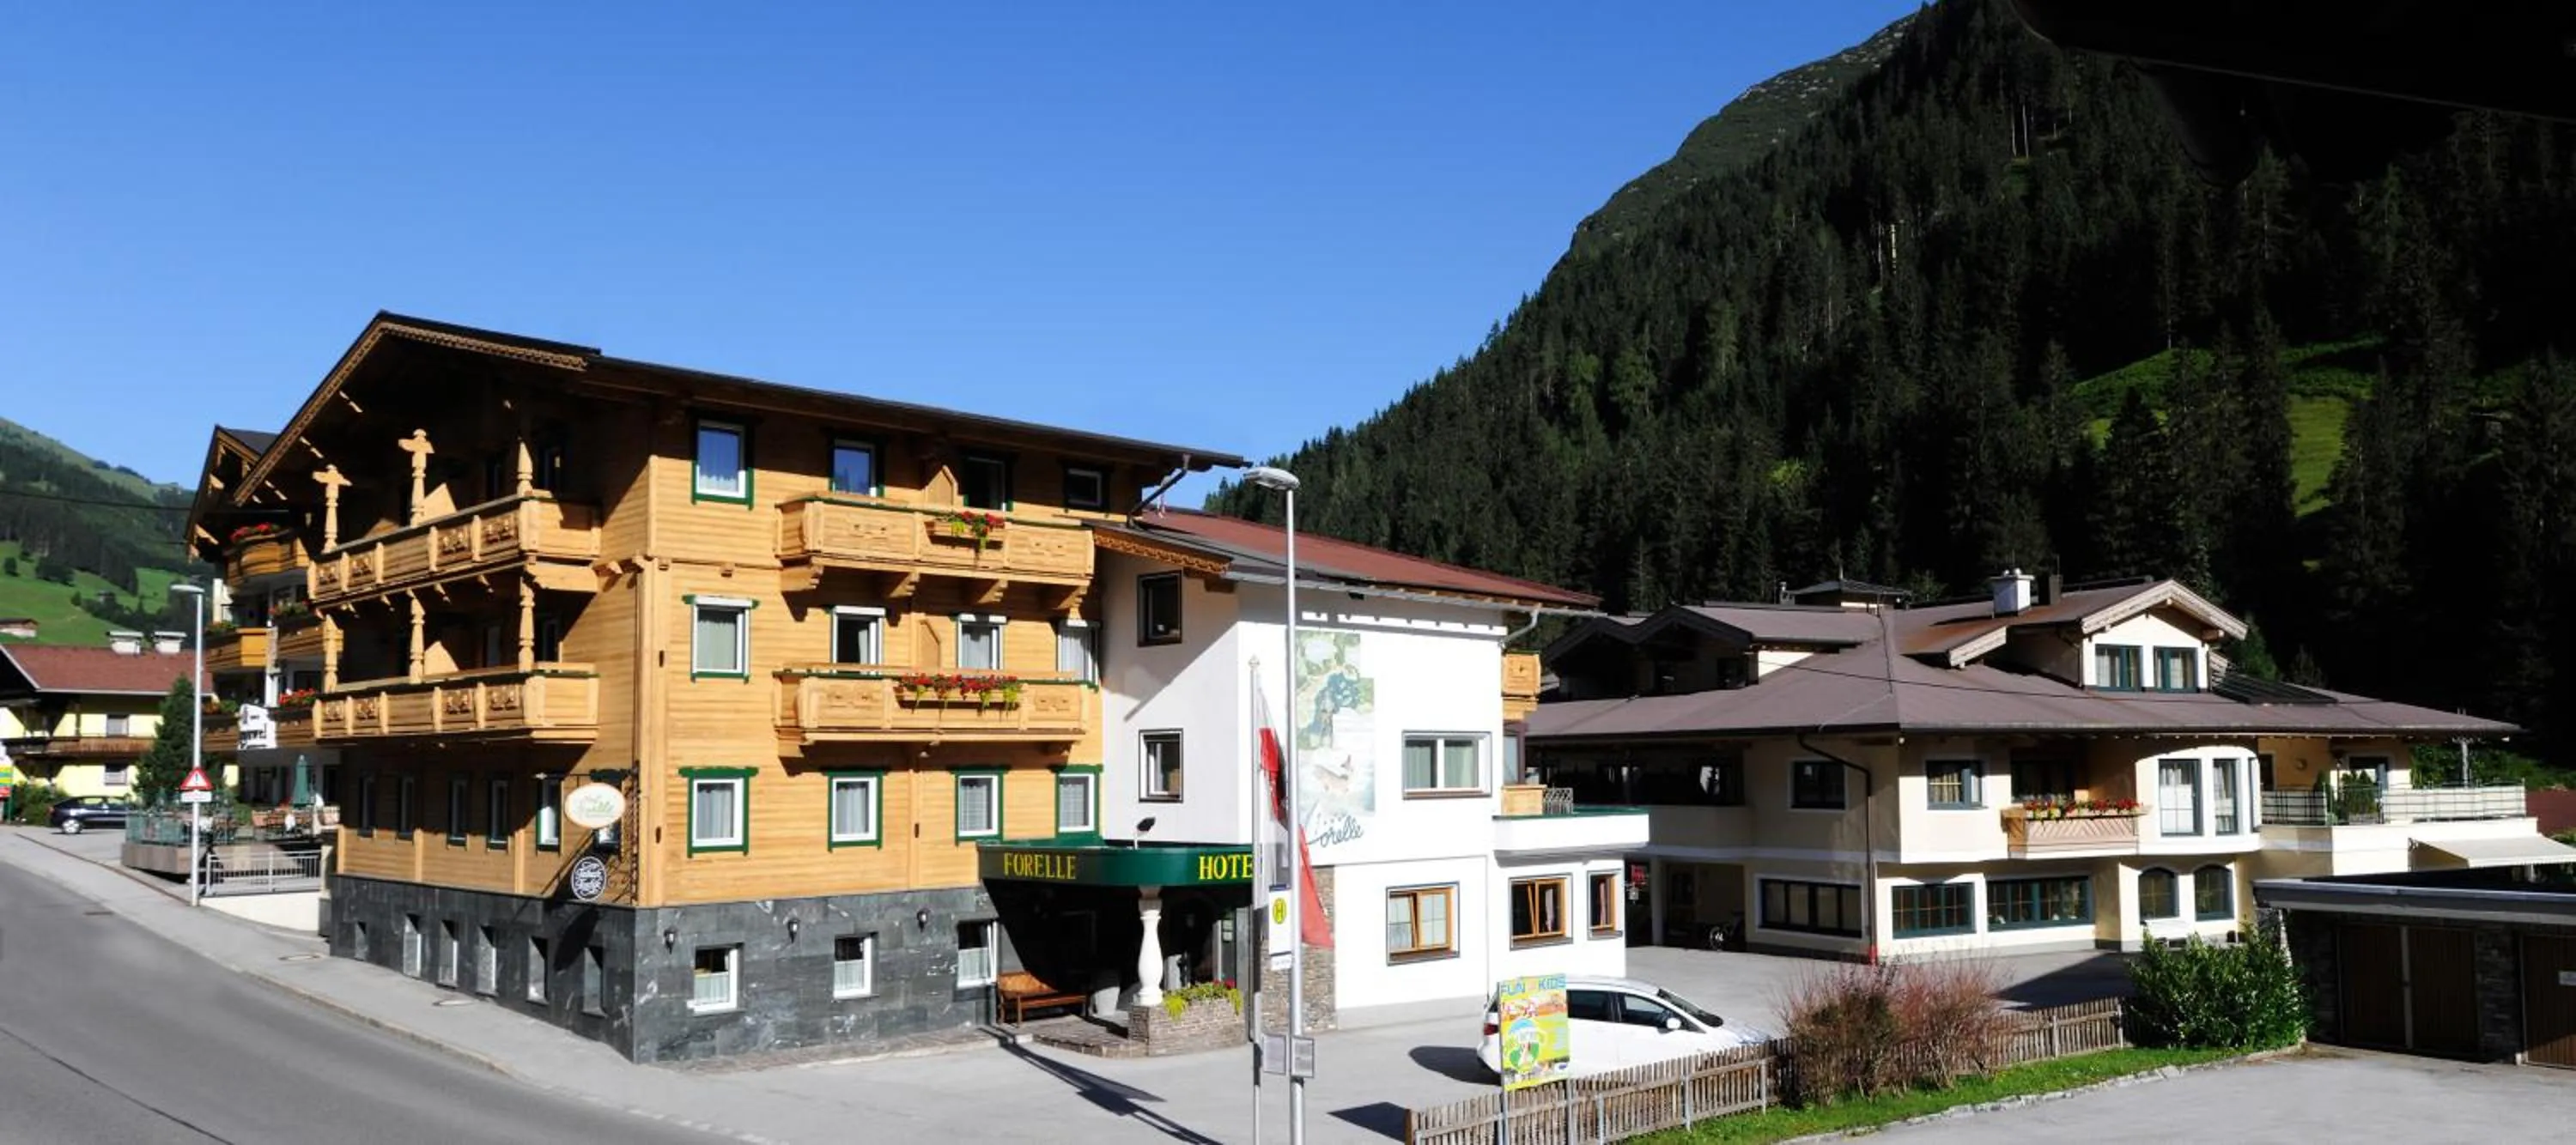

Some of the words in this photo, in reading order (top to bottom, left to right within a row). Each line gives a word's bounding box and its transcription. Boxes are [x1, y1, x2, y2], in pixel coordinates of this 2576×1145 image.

[1004, 852, 1076, 880] FORELLE
[1199, 854, 1253, 880] HOTE
[1538, 975, 1566, 990] KIDS
